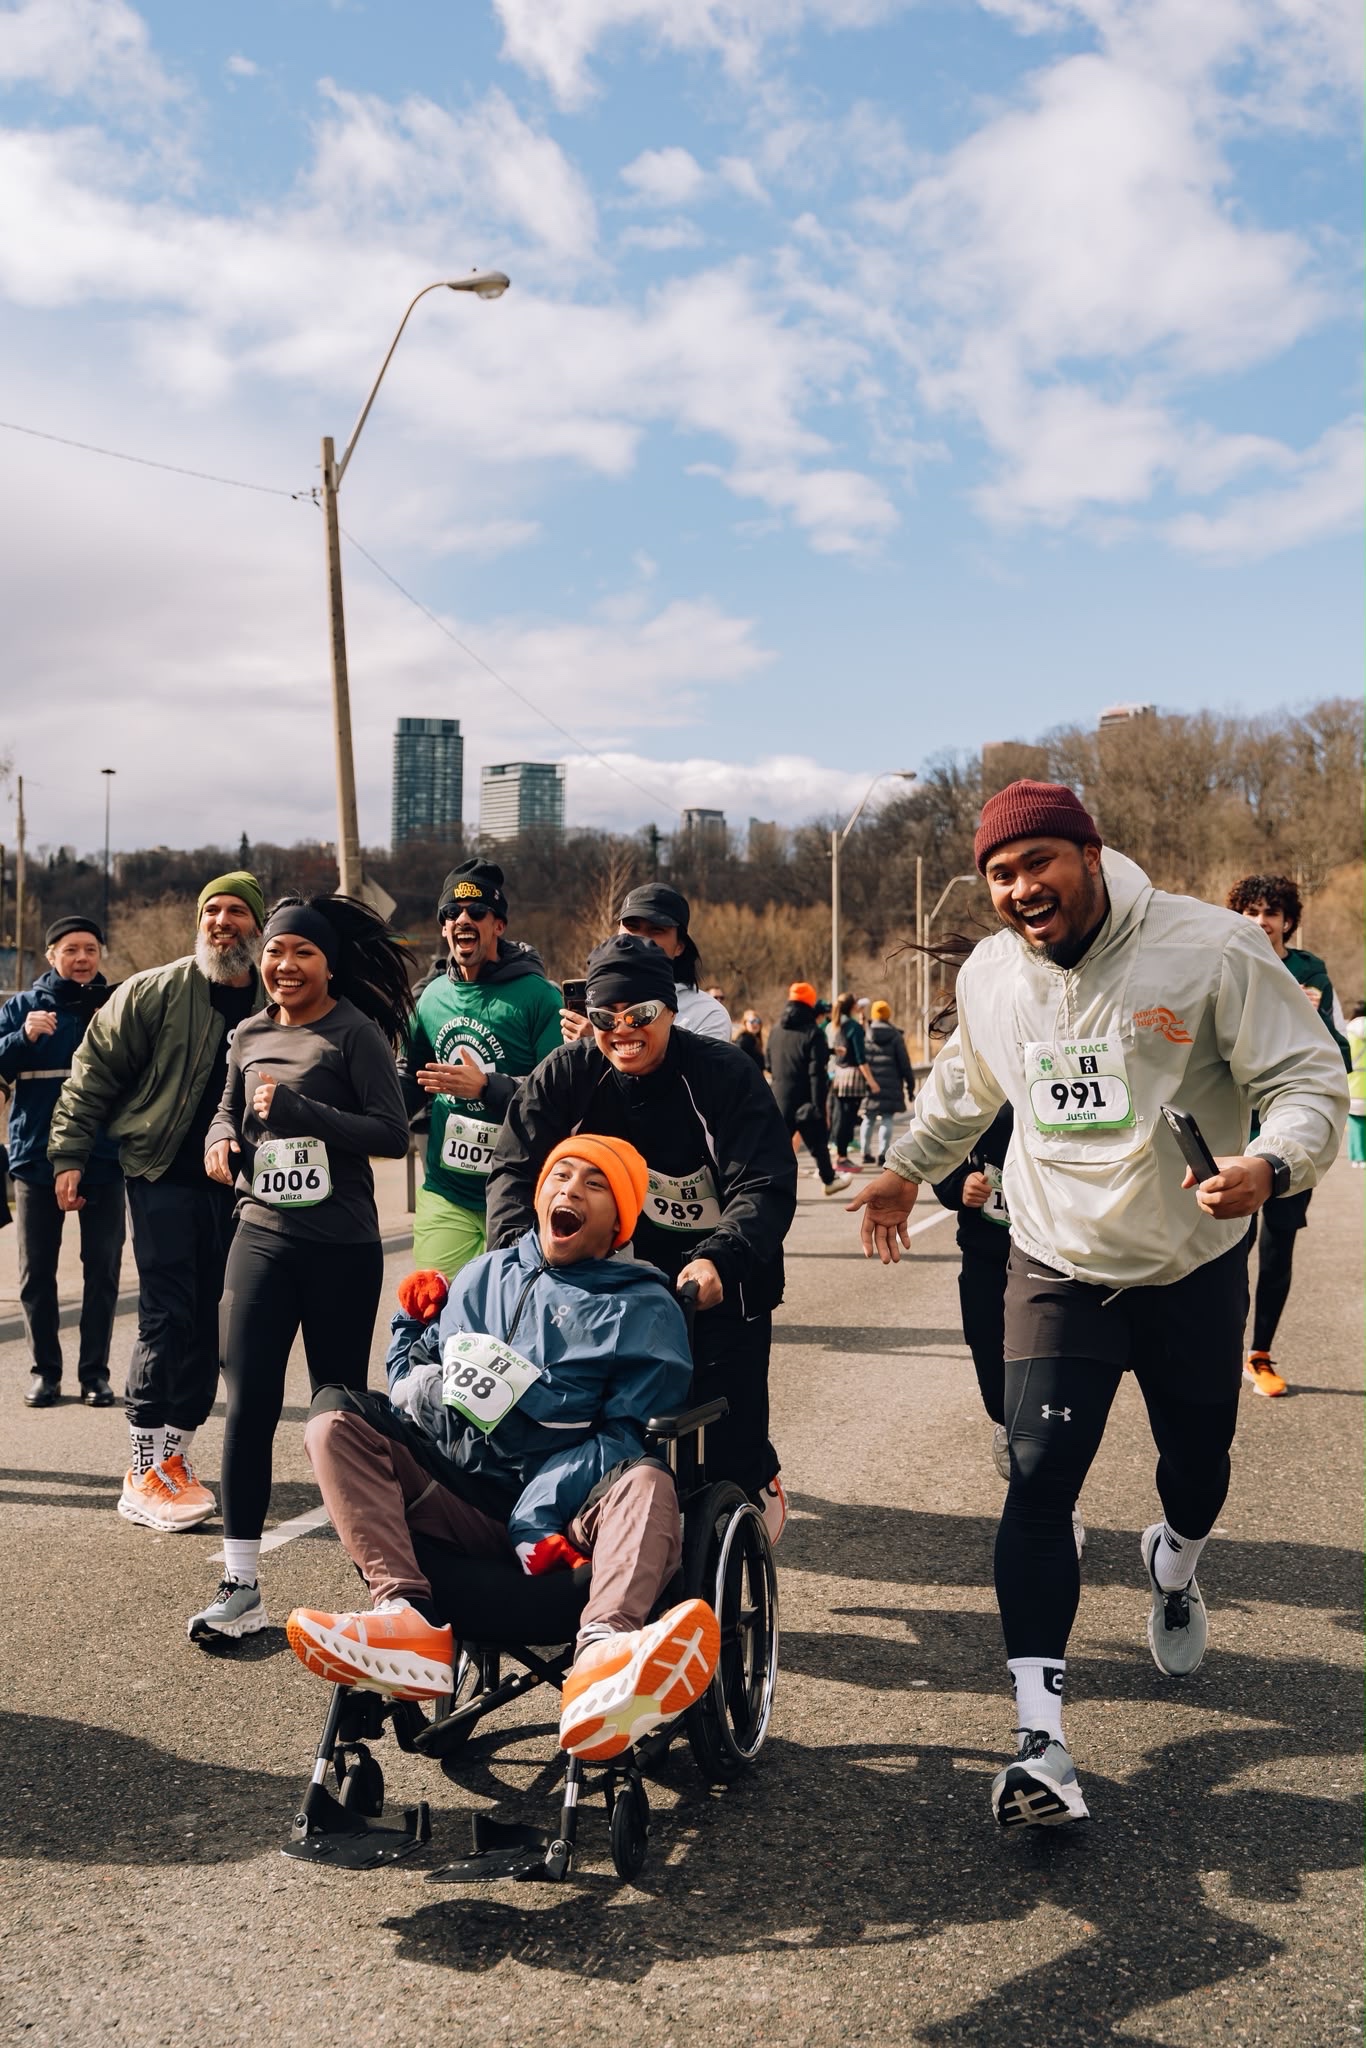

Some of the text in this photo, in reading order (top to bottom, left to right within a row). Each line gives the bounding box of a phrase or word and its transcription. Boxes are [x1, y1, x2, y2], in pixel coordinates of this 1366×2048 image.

[435, 1016, 470, 1049] PATRICK'S
[469, 1019, 490, 1037] DAY
[486, 1034, 505, 1060] RUN
[454, 1033, 490, 1058] ANNIVERSARY
[1064, 1043, 1109, 1055] 5K RACE
[1051, 1081, 1106, 1110] 991
[1066, 1110, 1097, 1121] Justin
[285, 1140, 318, 1150] 5K RACE
[449, 1140, 494, 1164] 1007
[261, 1168, 320, 1193] 1006
[682, 1173, 705, 1187] RACE
[280, 1192, 302, 1201] Alliza
[653, 1197, 704, 1221] 989
[671, 1219, 692, 1228] John
[489, 1343, 530, 1371] 5K RACE
